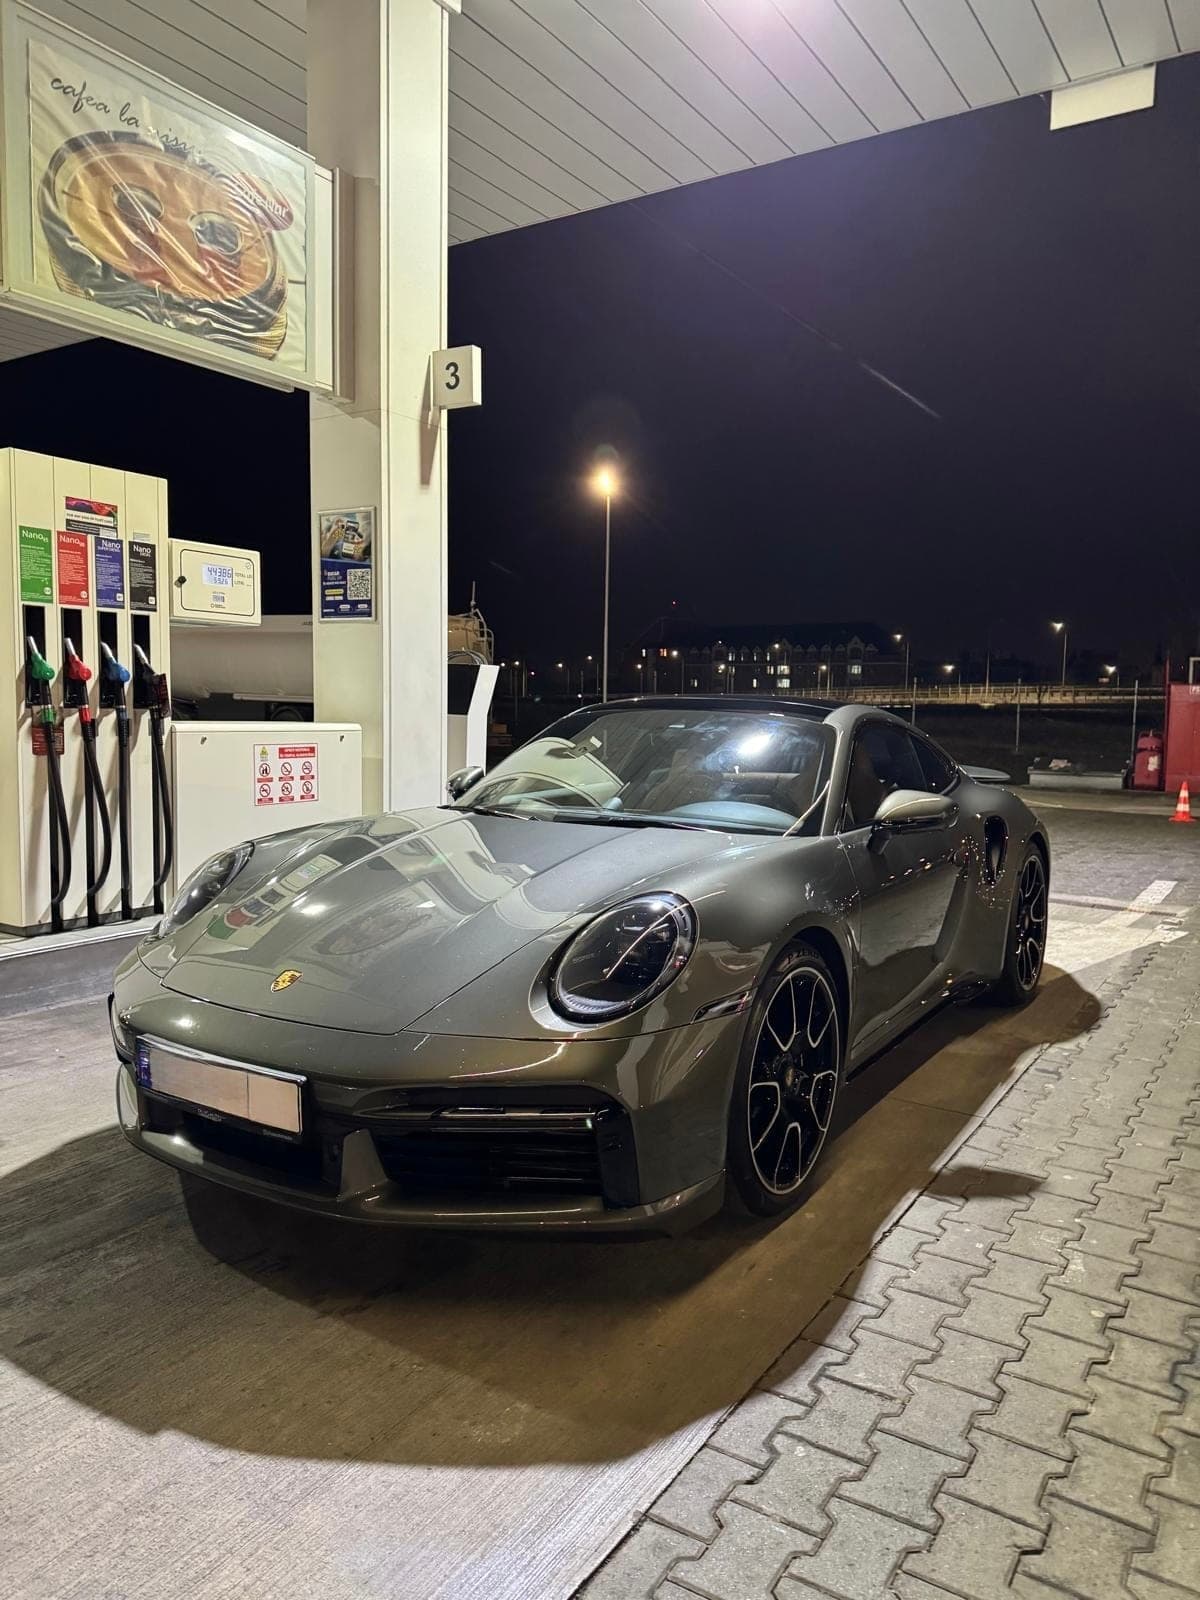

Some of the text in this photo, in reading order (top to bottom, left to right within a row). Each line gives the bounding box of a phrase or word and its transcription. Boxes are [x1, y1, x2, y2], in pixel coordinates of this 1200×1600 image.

[51, 77, 140, 128] cafea la
[445, 361, 460, 390] 3
[101, 539, 121, 549] Nano
[133, 544, 152, 554] Nano
